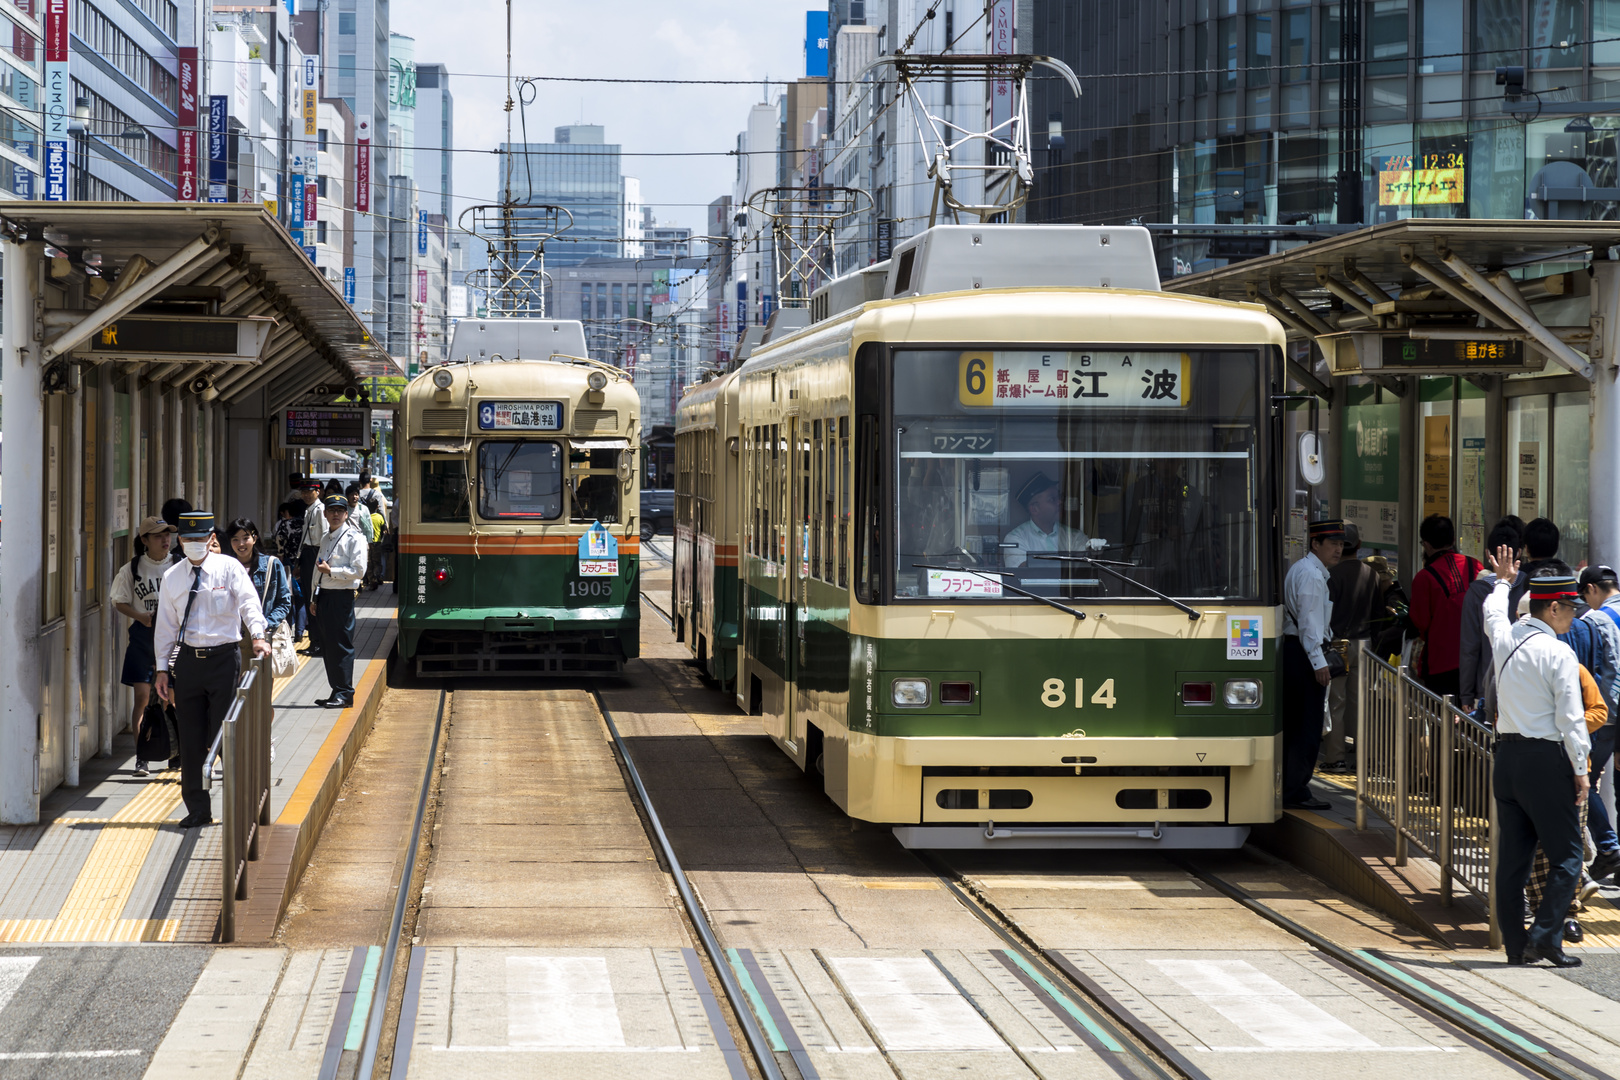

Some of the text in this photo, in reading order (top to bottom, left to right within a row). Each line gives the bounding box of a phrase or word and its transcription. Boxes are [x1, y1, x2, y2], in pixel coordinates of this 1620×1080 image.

[182, 62, 194, 112] Office 24
[50, 71, 65, 132] KUMON
[306, 92, 314, 132] 近鉄の仲介
[211, 99, 221, 159] アパマンショップ
[1423, 153, 1465, 170] 12:34
[1386, 181, 1457, 192] エイチ・アイ・エス
[102, 324, 118, 345] 駅
[1402, 342, 1417, 360] 西
[965, 359, 986, 395] 6
[996, 369, 1070, 383] 紙屋町
[1072, 369, 1178, 400] 江波
[996, 384, 1070, 399] 原爆ドーム前
[295, 412, 318, 420] 広島駅
[482, 406, 492, 424] 3
[295, 420, 318, 428] 広島港
[933, 435, 993, 450] ワンマン
[581, 564, 607, 573] フラワー
[417, 556, 427, 604] 乗降者優先
[942, 578, 984, 592] フラワー
[569, 581, 613, 597] 1905
[1230, 648, 1259, 657] PASPY
[1040, 678, 1117, 709] 814
